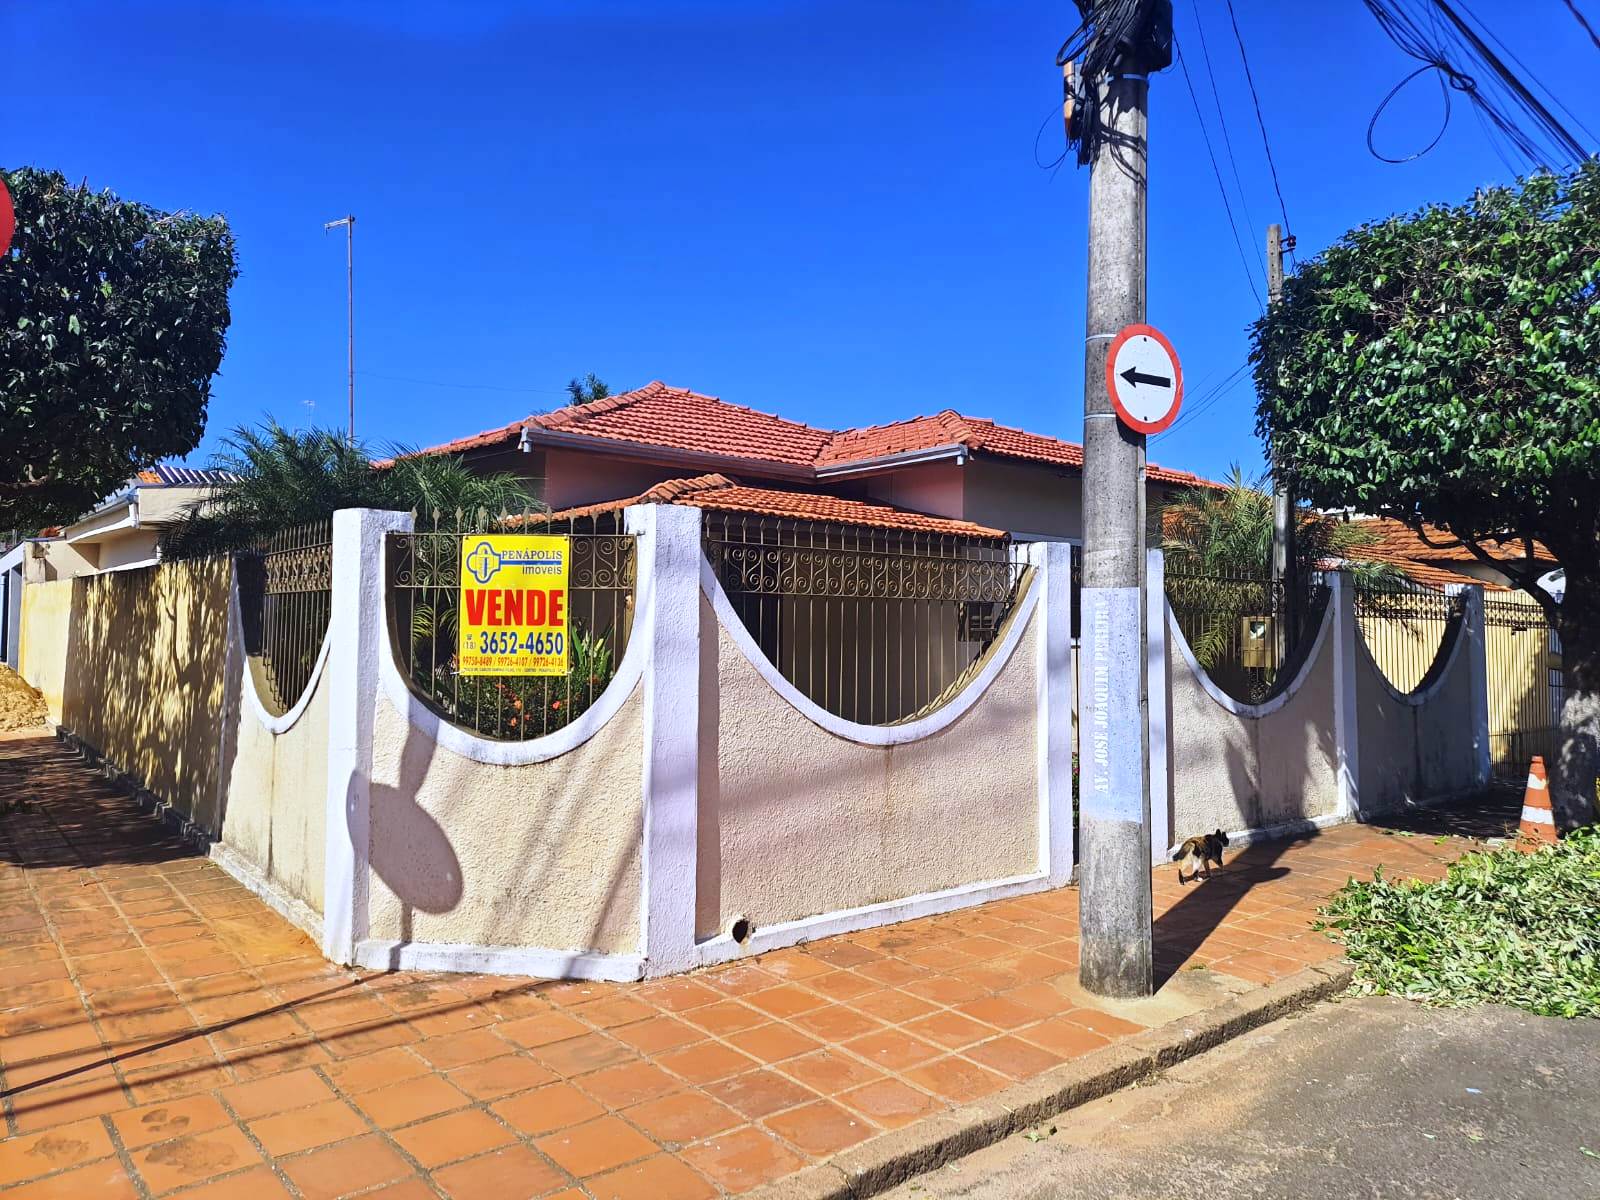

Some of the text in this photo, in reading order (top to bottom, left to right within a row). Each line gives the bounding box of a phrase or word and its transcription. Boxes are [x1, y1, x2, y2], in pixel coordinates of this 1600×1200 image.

[502, 547, 562, 559] PENÁPOLIS
[465, 589, 564, 627] VENDE
[463, 631, 564, 655] (18) 3652-4650
[1094, 666, 1109, 729] JOAQUIM
[1094, 771, 1109, 794] AV.
